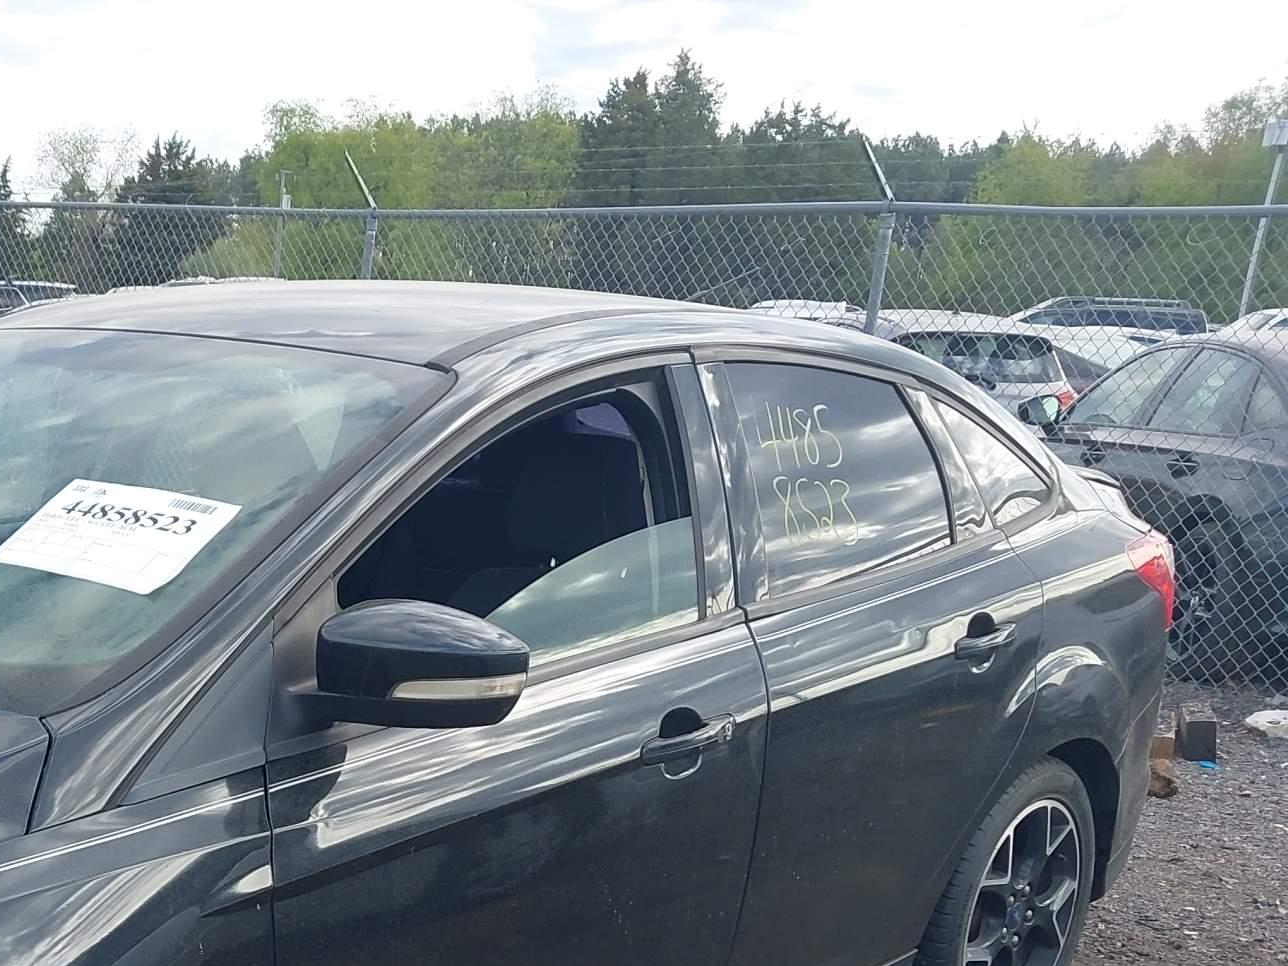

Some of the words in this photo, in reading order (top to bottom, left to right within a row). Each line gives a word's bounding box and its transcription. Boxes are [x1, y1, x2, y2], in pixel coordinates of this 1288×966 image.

[753, 401, 843, 472] 4485
[61, 499, 198, 536] 44858523
[772, 475, 859, 546] 8523
